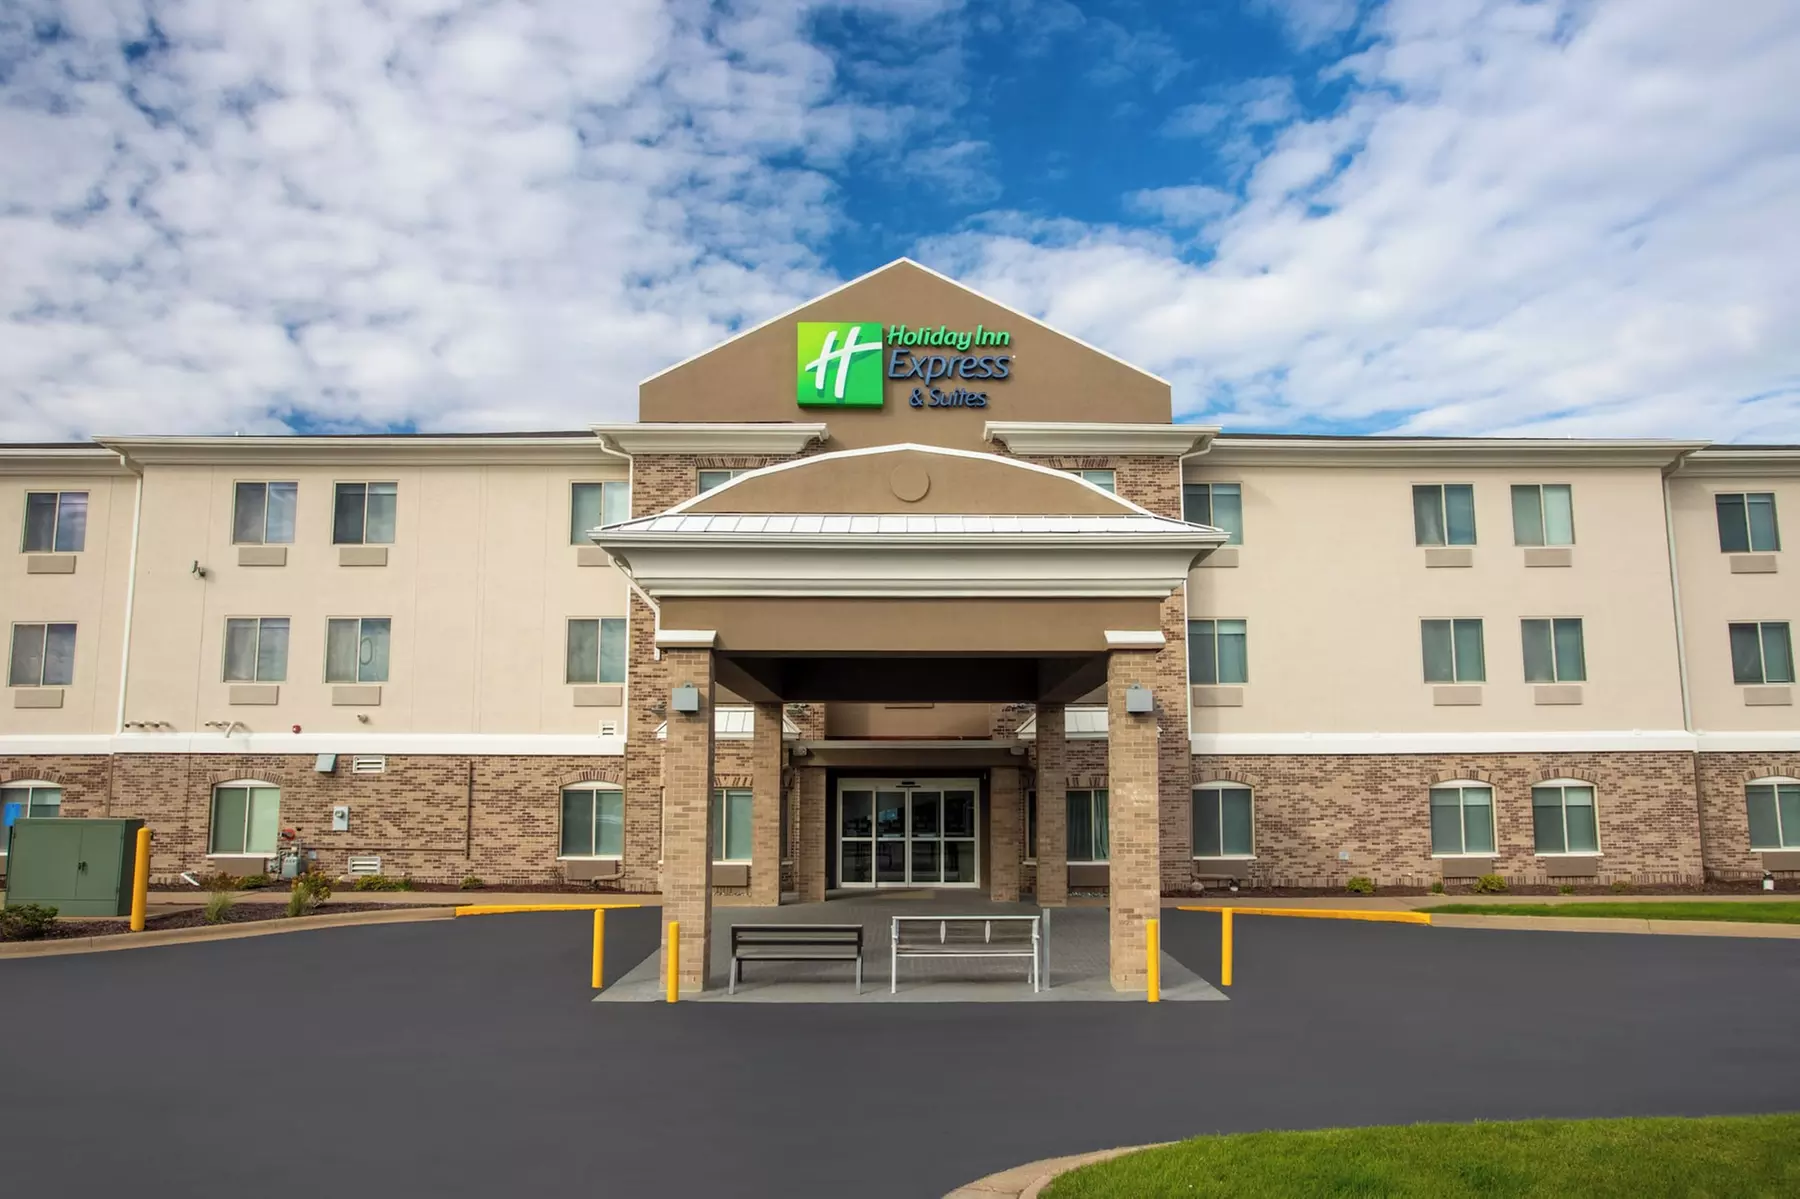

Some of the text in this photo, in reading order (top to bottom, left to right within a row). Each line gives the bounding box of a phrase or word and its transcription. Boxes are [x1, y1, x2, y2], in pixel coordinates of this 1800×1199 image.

[887, 324, 1010, 350] Holiday Inn
[805, 326, 882, 398] H
[888, 349, 1009, 386] Express
[909, 387, 987, 407] & Suites
